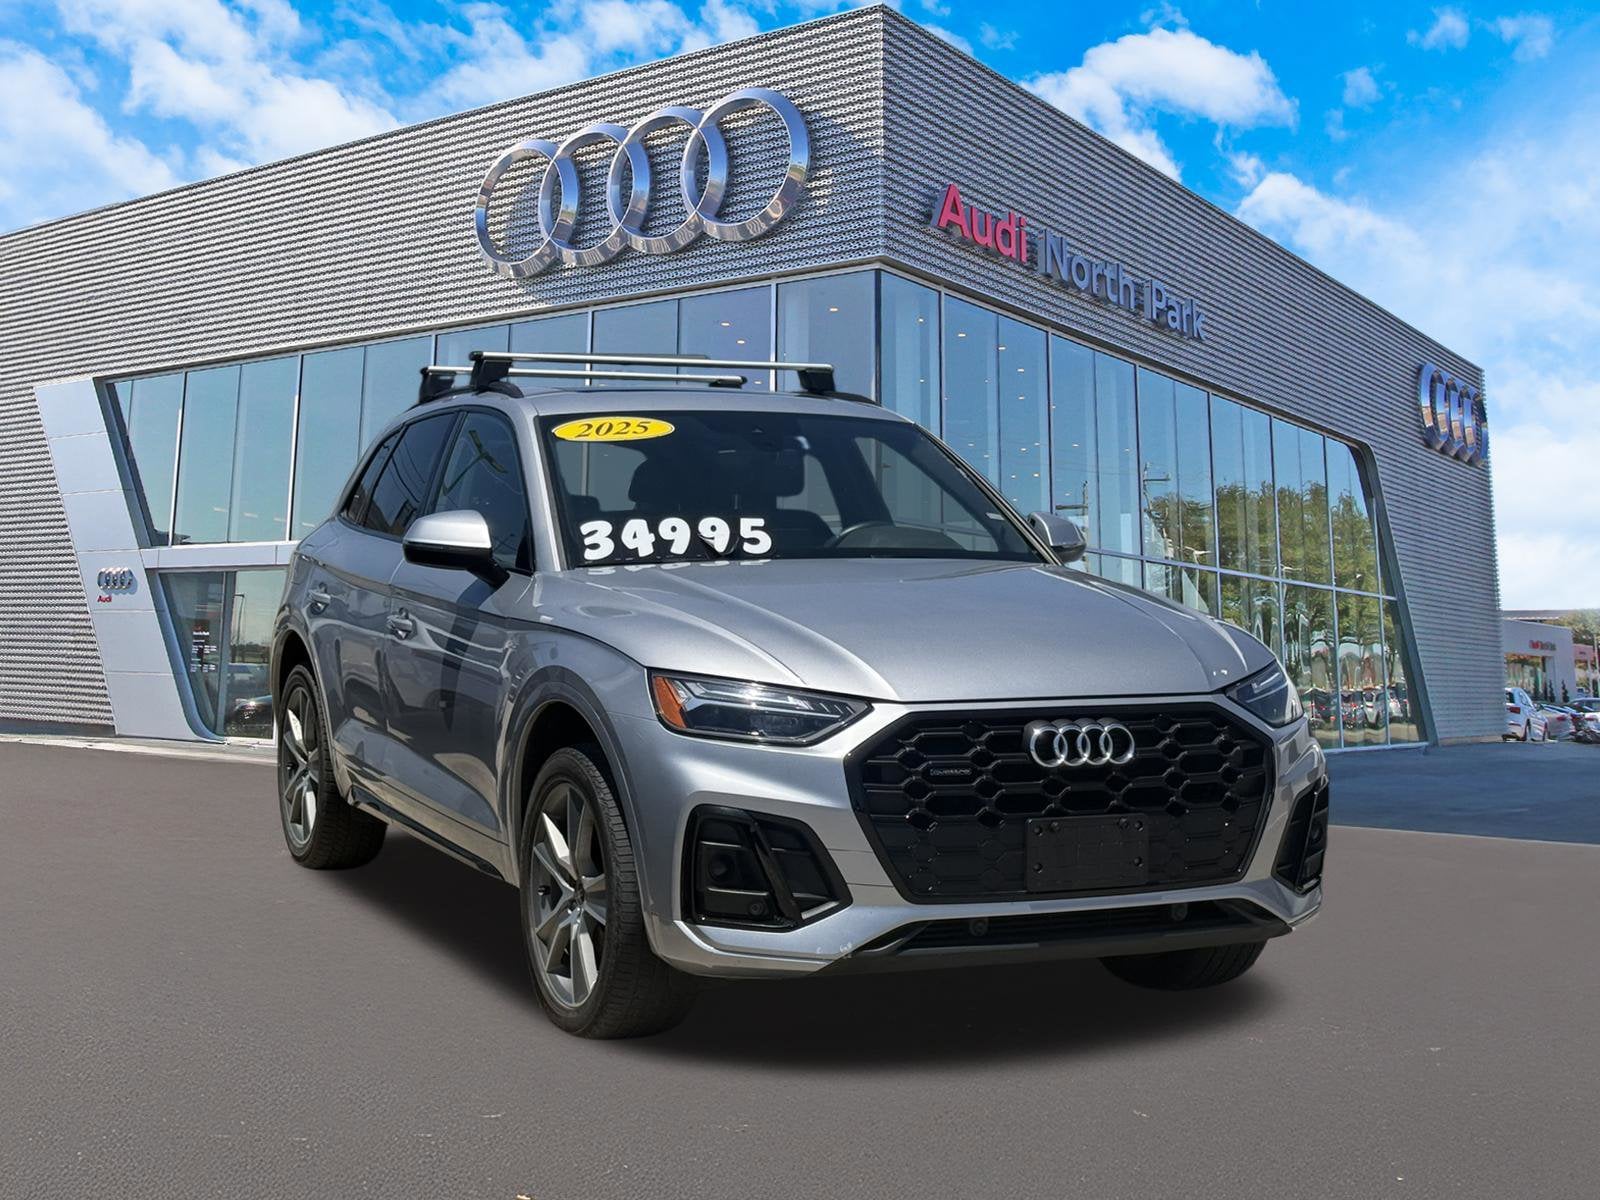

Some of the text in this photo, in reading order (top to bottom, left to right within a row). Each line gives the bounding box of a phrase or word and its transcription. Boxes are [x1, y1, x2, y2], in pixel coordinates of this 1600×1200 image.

[935, 183, 1207, 341] Audi North Park
[575, 421, 651, 438] 2025
[579, 516, 773, 561] 34995
